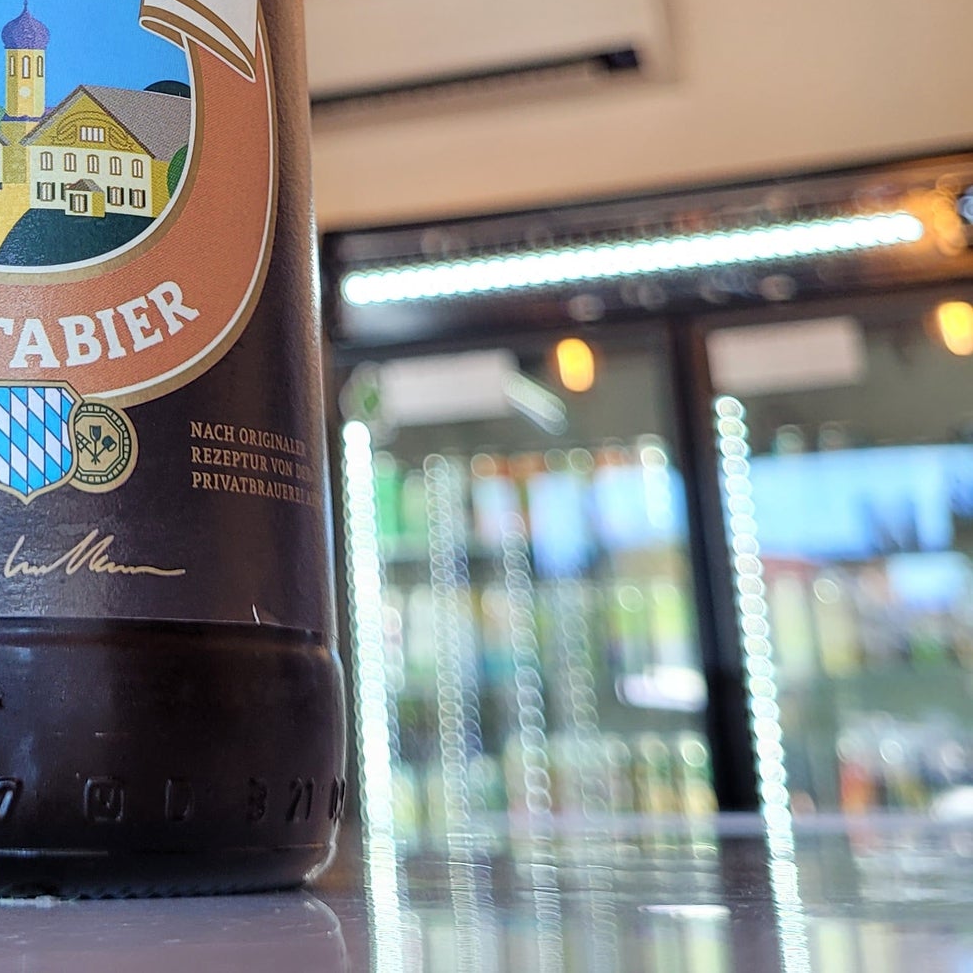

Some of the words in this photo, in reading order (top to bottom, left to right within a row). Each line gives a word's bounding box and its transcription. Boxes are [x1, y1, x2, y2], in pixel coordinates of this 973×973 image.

[190, 421, 235, 442] NACH
[191, 446, 268, 473] REZEPTUR
[270, 457, 293, 477] VON
